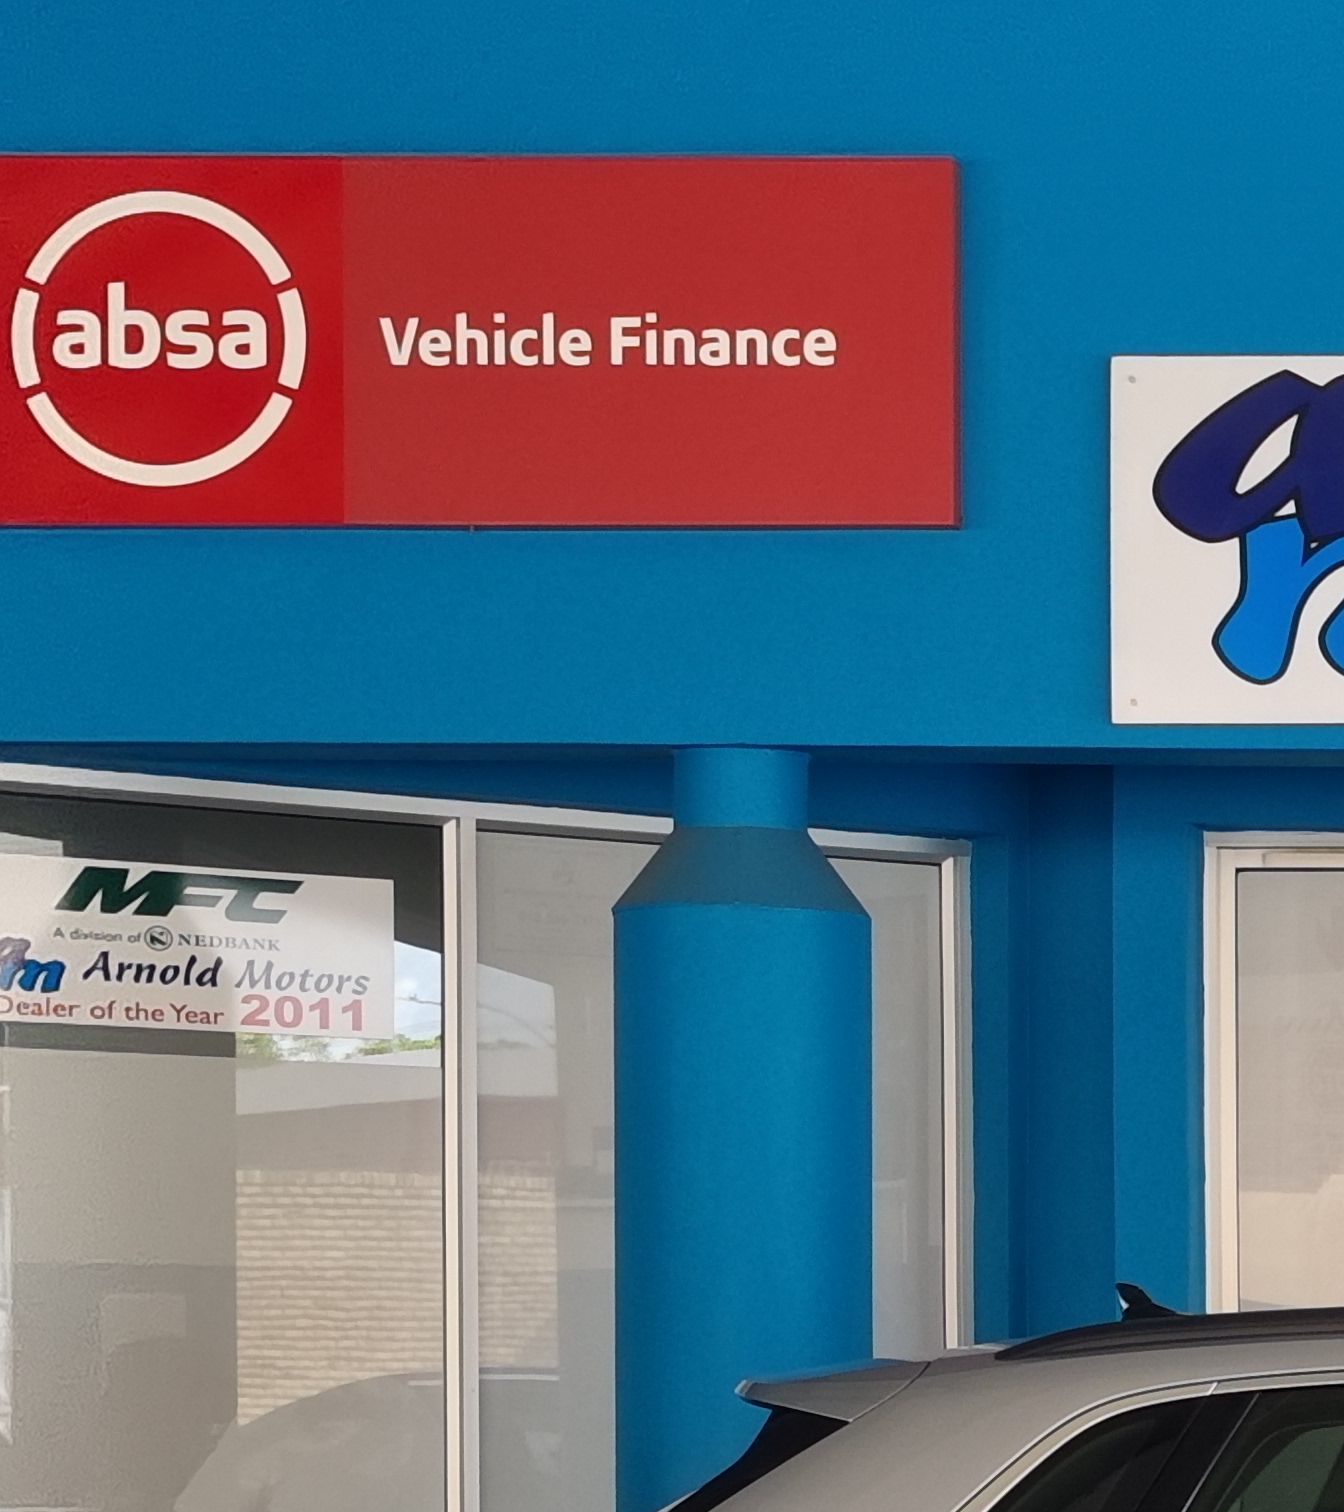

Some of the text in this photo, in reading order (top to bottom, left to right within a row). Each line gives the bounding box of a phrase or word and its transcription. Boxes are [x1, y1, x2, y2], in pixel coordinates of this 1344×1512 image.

[52, 281, 268, 369] absa
[380, 313, 837, 367] Vehicle Finance
[54, 866, 304, 924] MFC
[53, 927, 281, 951] A division of NEDBANK
[82, 950, 370, 995] Arnold Motors
[90, 1000, 117, 1020] of
[124, 1002, 165, 1022] the
[170, 1003, 225, 1025] Year
[240, 993, 362, 1032] 2011
